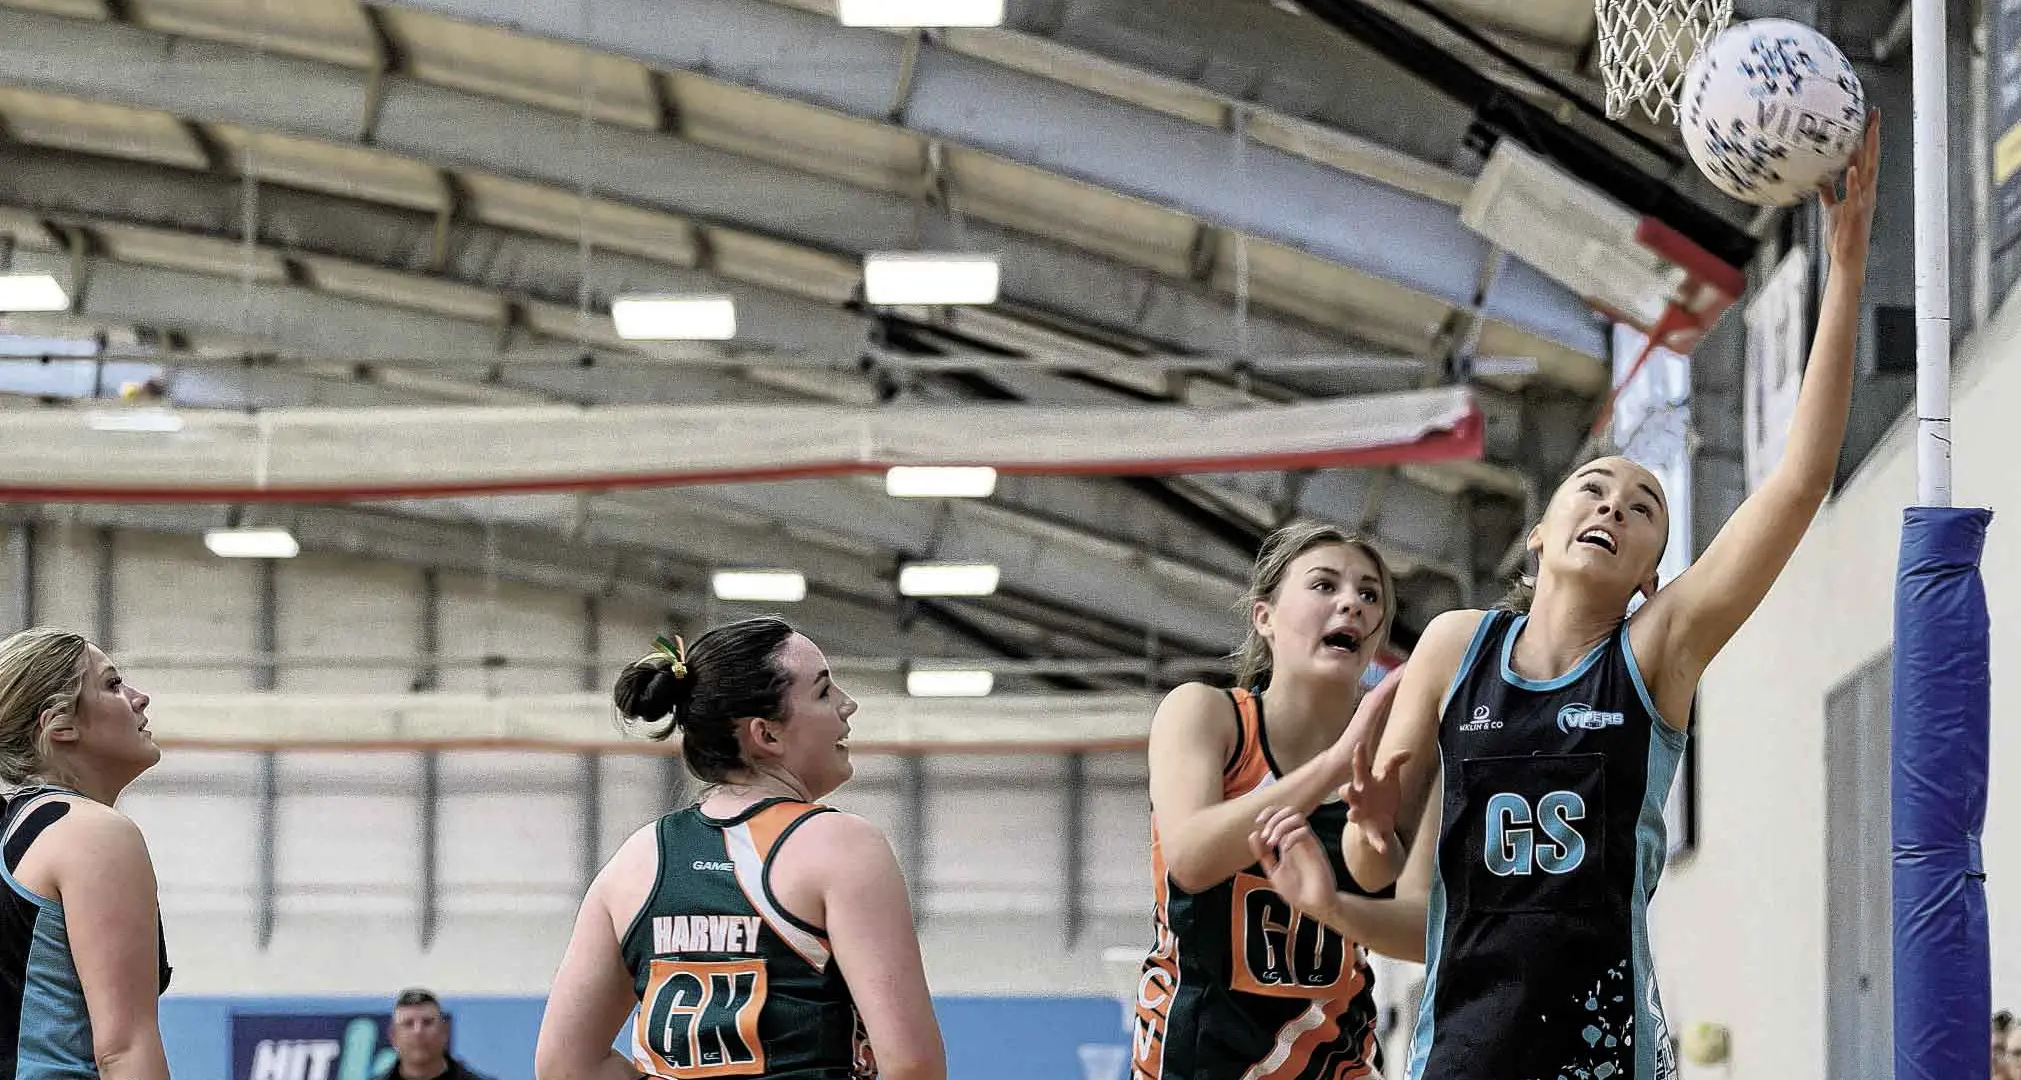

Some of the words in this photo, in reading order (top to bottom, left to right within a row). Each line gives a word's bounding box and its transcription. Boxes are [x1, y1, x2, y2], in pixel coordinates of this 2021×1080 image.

[1490, 720, 1504, 729] CO
[1484, 790, 1586, 877] GS
[692, 860, 734, 872] GAME
[652, 915, 762, 954] HARVEY
[647, 971, 758, 1069] GK
[250, 1038, 341, 1080] HIT
